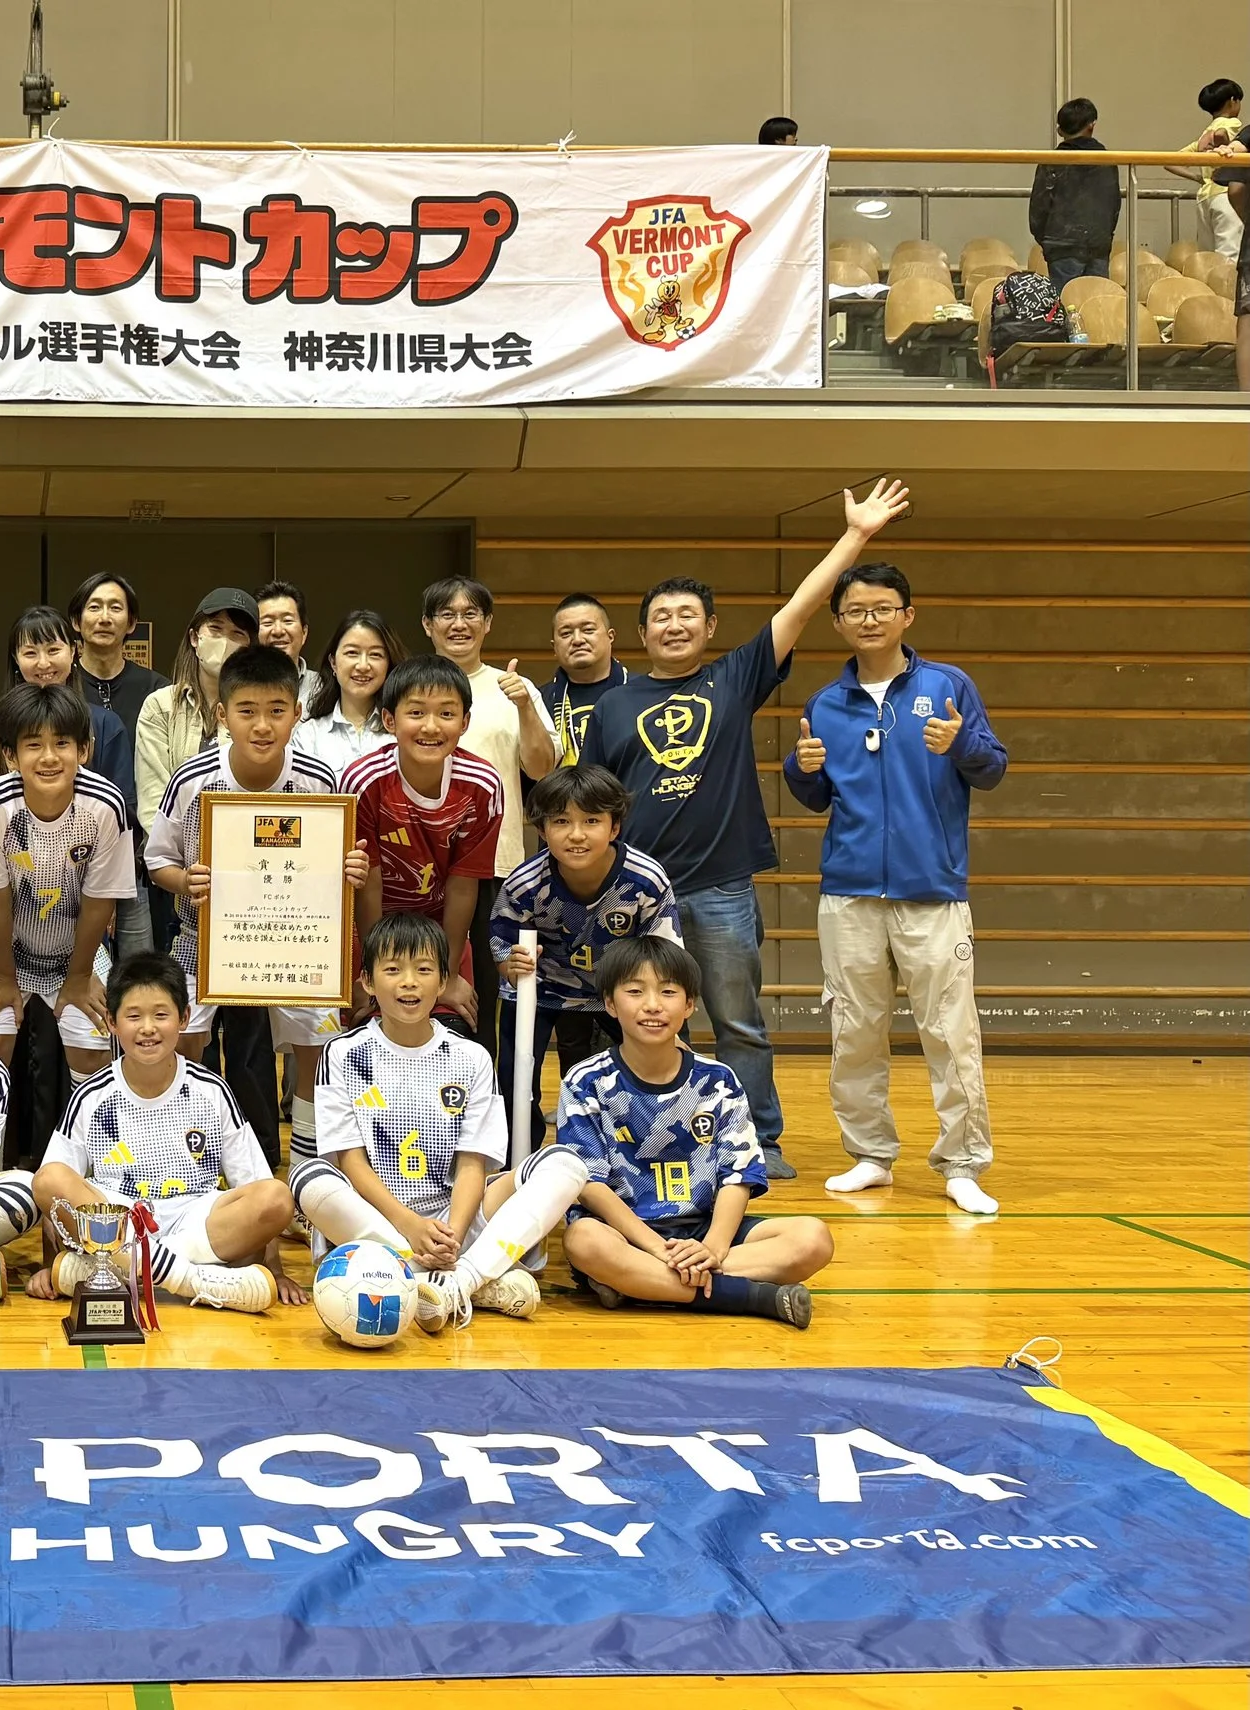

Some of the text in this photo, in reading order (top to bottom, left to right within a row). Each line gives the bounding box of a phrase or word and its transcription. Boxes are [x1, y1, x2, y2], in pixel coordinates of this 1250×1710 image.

[649, 208, 686, 225] JFA
[613, 223, 726, 254] VERMONT
[646, 253, 694, 278] CUP
[283, 330, 533, 373] 神奈川県大会
[257, 818, 274, 827] JFA
[37, 887, 62, 920] 7
[398, 1130, 428, 1179] 6
[650, 1161, 692, 1202] 18
[362, 1270, 393, 1280] molten
[29, 1426, 1028, 1508] PORTA
[10, 1510, 655, 1562] HUNGRY
[760, 1529, 1098, 1556] fcporta.com
